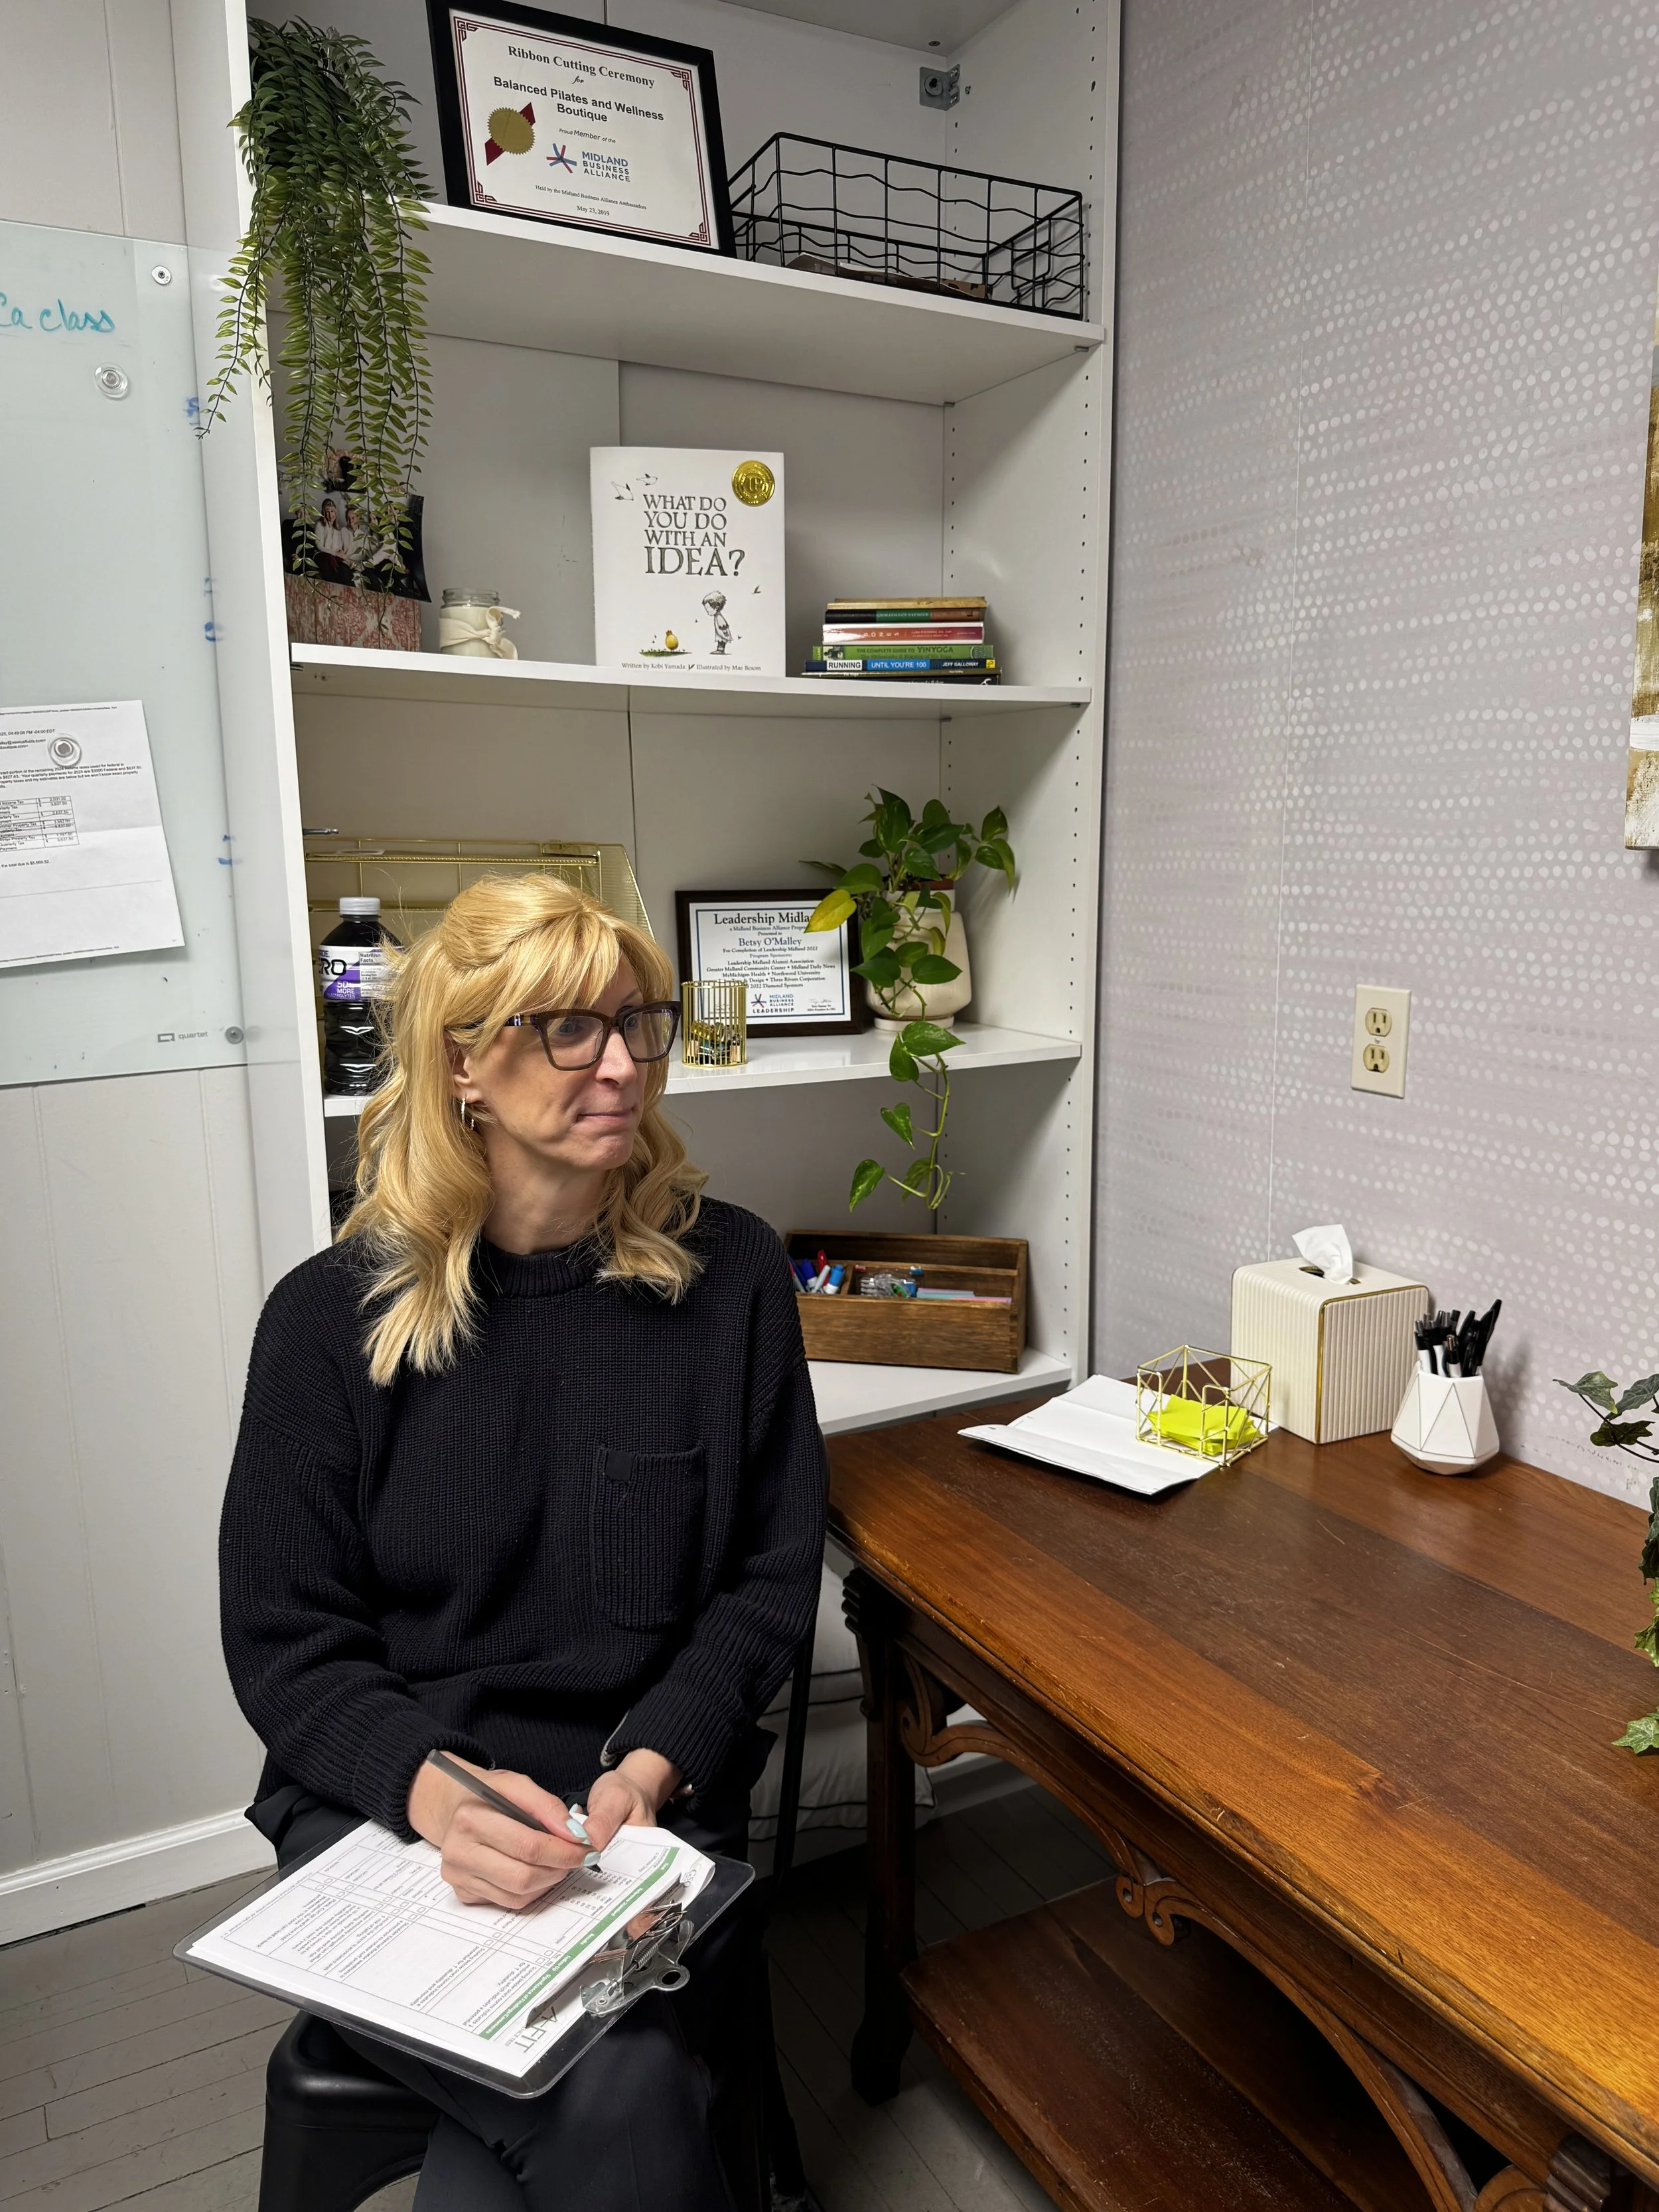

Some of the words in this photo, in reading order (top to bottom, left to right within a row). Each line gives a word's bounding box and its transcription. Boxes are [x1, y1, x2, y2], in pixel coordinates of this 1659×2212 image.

[508, 46, 549, 64] Ribbon
[553, 56, 597, 76] Cutting
[599, 66, 655, 88] Ceremony
[571, 76, 584, 84] for
[494, 76, 547, 96] Balanced
[551, 88, 588, 105] Pilates
[592, 99, 612, 110] and
[614, 102, 664, 121] Wellness
[557, 103, 608, 121] Boutique
[574, 130, 601, 140] Member
[582, 151, 628, 167] MIDLAND
[583, 161, 630, 175] BUSINESS
[584, 169, 630, 183] ALLIANCE
[619, 201, 647, 210] Ambassadors
[39, 299, 115, 332] class
[643, 494, 695, 511] WHAT
[699, 497, 727, 512] DO
[644, 511, 687, 529] YOU
[695, 513, 727, 530] DO
[644, 530, 695, 547] WITH
[701, 532, 727, 548] AN
[644, 546, 745, 577] IDEA?
[713, 912, 775, 925] Leadership
[778, 911, 810, 922] Midla
[738, 938, 762, 948] Betsy
[763, 937, 802, 946] O'Malley
[179, 1031, 208, 1040] quartet
[462, 1946, 479, 1960] potential
[469, 1949, 486, 1960] Scoring
[459, 1959, 472, 1970] below
[557, 1955, 571, 1966] Follow
[435, 1968, 453, 1983] disability
[520, 1966, 536, 1979] Scoring
[437, 1978, 450, 1988] norms
[499, 1982, 511, 1992] which
[511, 1978, 524, 1990] below
[527, 1974, 551, 1995] Significance
[419, 1988, 439, 2003] indicates
[483, 1992, 500, 2007] indicates
[500, 1988, 512, 1998] one's
[490, 1998, 503, 2010] norms
[462, 2010, 480, 2026] potential
[472, 2008, 491, 2024] indicates
[486, 1998, 526, 2033] Findings/Comments
[504, 2037, 516, 2047] TEST
